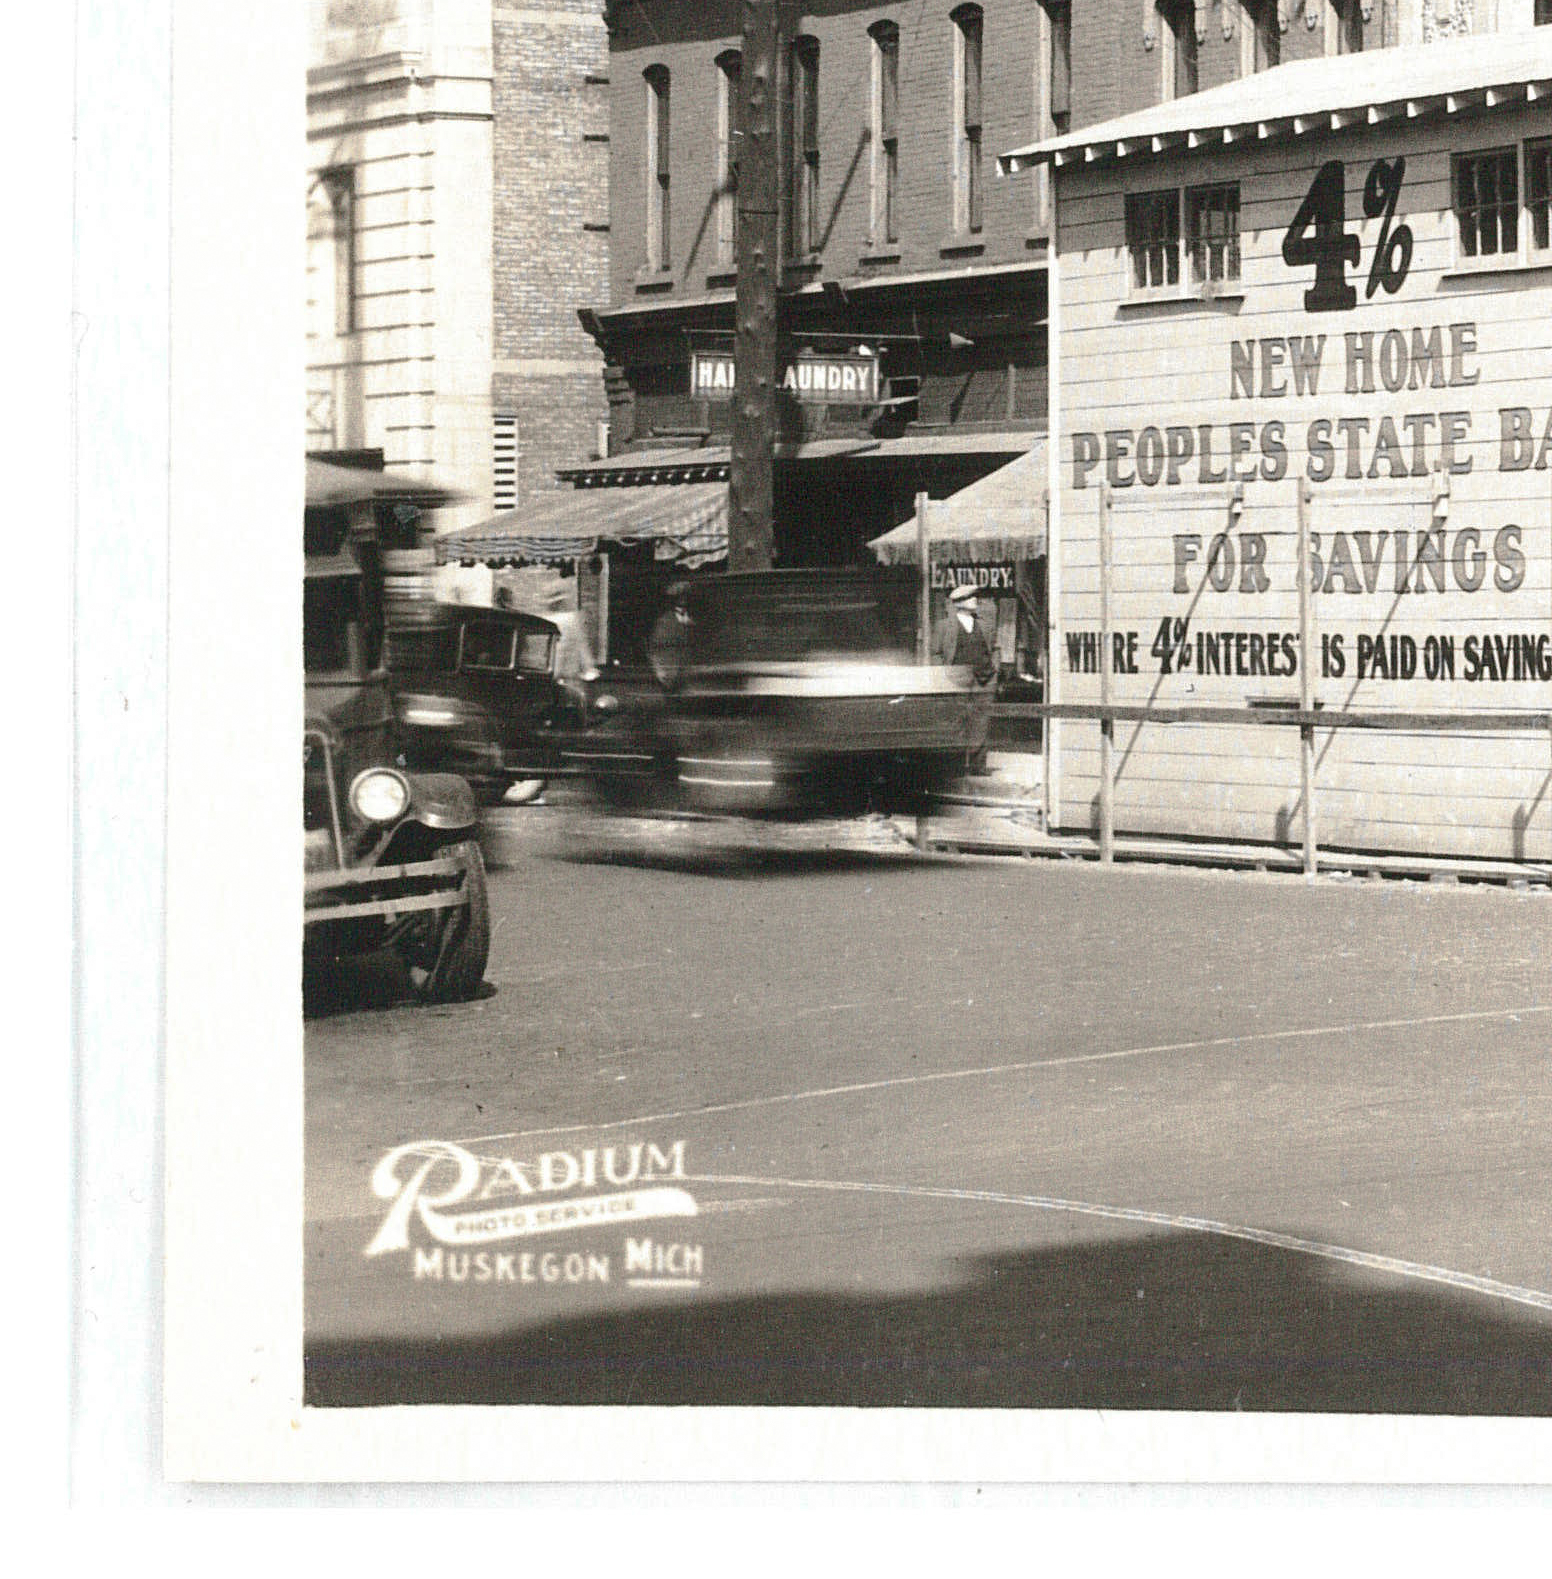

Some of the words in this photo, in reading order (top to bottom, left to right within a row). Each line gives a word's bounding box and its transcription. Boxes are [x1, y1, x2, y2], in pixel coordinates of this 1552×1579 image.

[1281, 155, 1413, 313] 4%
[783, 364, 870, 391] AUNDRY
[1230, 333, 1328, 400] NEW
[1344, 321, 1481, 394] HOME
[1072, 419, 1288, 490] PEOPLES
[1305, 410, 1473, 483] STATE
[1172, 532, 1271, 594] FOR
[1296, 524, 1526, 594] SAVINGS
[1066, 631, 1138, 674] WHRE
[1151, 616, 1193, 675] 4%
[1196, 631, 1301, 677] INTERES
[1321, 633, 1346, 679] IS
[1357, 633, 1418, 681] PAID
[1424, 634, 1455, 681] ON
